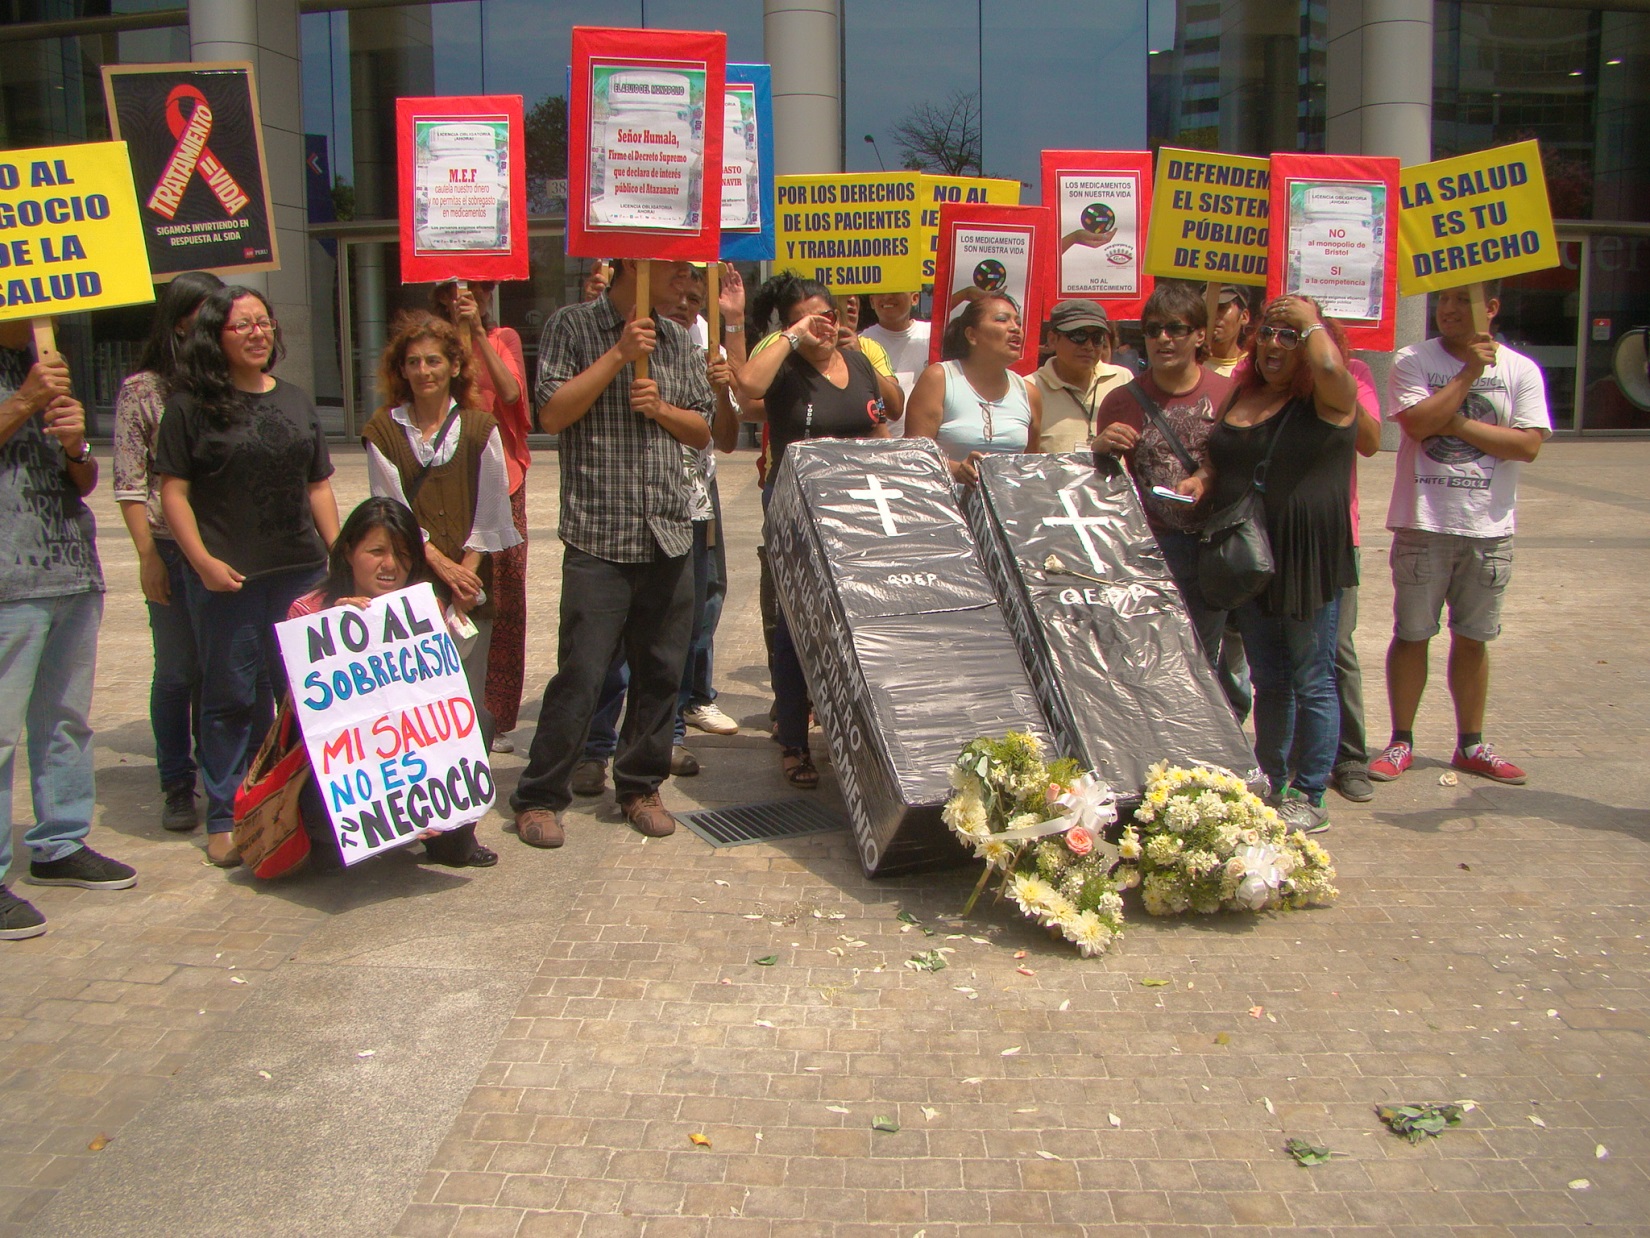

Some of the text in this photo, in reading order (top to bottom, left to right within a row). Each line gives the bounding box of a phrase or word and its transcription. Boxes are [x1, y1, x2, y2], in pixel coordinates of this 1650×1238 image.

[614, 83, 620, 93] EL
[638, 84, 650, 94] DEL
[651, 85, 684, 95] MONOPOLIO
[617, 129, 679, 148] Señor Humala,
[149, 104, 213, 216] TRATAMIENTO
[209, 168, 248, 215] VIDA
[608, 150, 687, 165] Firme el Decreto Supremo
[0, 160, 74, 190] O AL
[449, 169, 477, 183] M.E.F
[614, 167, 681, 179] que declara de interés
[722, 166, 741, 174] ASTO
[435, 183, 489, 193] cautela nuestro dinero
[615, 182, 679, 195] público el Atazanavir
[778, 182, 915, 205] POR LOS DERECHOS
[933, 185, 989, 203] NO AL
[1069, 190, 1131, 198] SON NUESTRA VIDA
[1400, 161, 1528, 210] LA SALUD
[0, 194, 110, 230] GOCIO
[432, 197, 438, 205] no
[440, 196, 461, 207] permitas
[463, 196, 467, 205] el
[468, 196, 495, 208] sobregasto
[443, 207, 486, 217] en medicamentos
[1172, 190, 1270, 219] EL SISTEM
[156, 219, 249, 236] SIGAMOS INVIRTIENDO EN
[784, 213, 801, 232] DE
[805, 213, 830, 232] LOS
[835, 210, 911, 231] PACIENTES
[1431, 201, 1508, 238] ES TU
[171, 231, 241, 246] RESPUESTA AL SIDA
[960, 235, 1025, 245] LOS MEDICAMENTOS
[1182, 218, 1269, 248] PÚBLICO
[1329, 229, 1346, 238] NO
[0, 235, 87, 268] DE LA
[786, 242, 795, 259] Y
[799, 237, 909, 259] TRABAJADORES
[979, 246, 1009, 254] NUESTRA
[1412, 230, 1540, 278] DERECHO
[1174, 247, 1268, 275] DE SALUD
[1330, 266, 1341, 275] SI
[815, 265, 882, 285] DE SALUD
[1319, 278, 1366, 286] competencia
[1427, 372, 1498, 387] VNY USIC
[1452, 478, 1488, 488] SOUL
[306, 596, 434, 663] NO AL
[794, 557, 821, 637] HUBO
[822, 644, 861, 750] DINERO
[831, 622, 863, 702] JUAN
[303, 632, 460, 711] SOBREGASTO
[770, 533, 878, 872] PARA SU TRATAMIENTO
[323, 697, 475, 774] MI SALUD
[330, 751, 427, 812] NO ES
[359, 757, 495, 849] NEGOCIO
